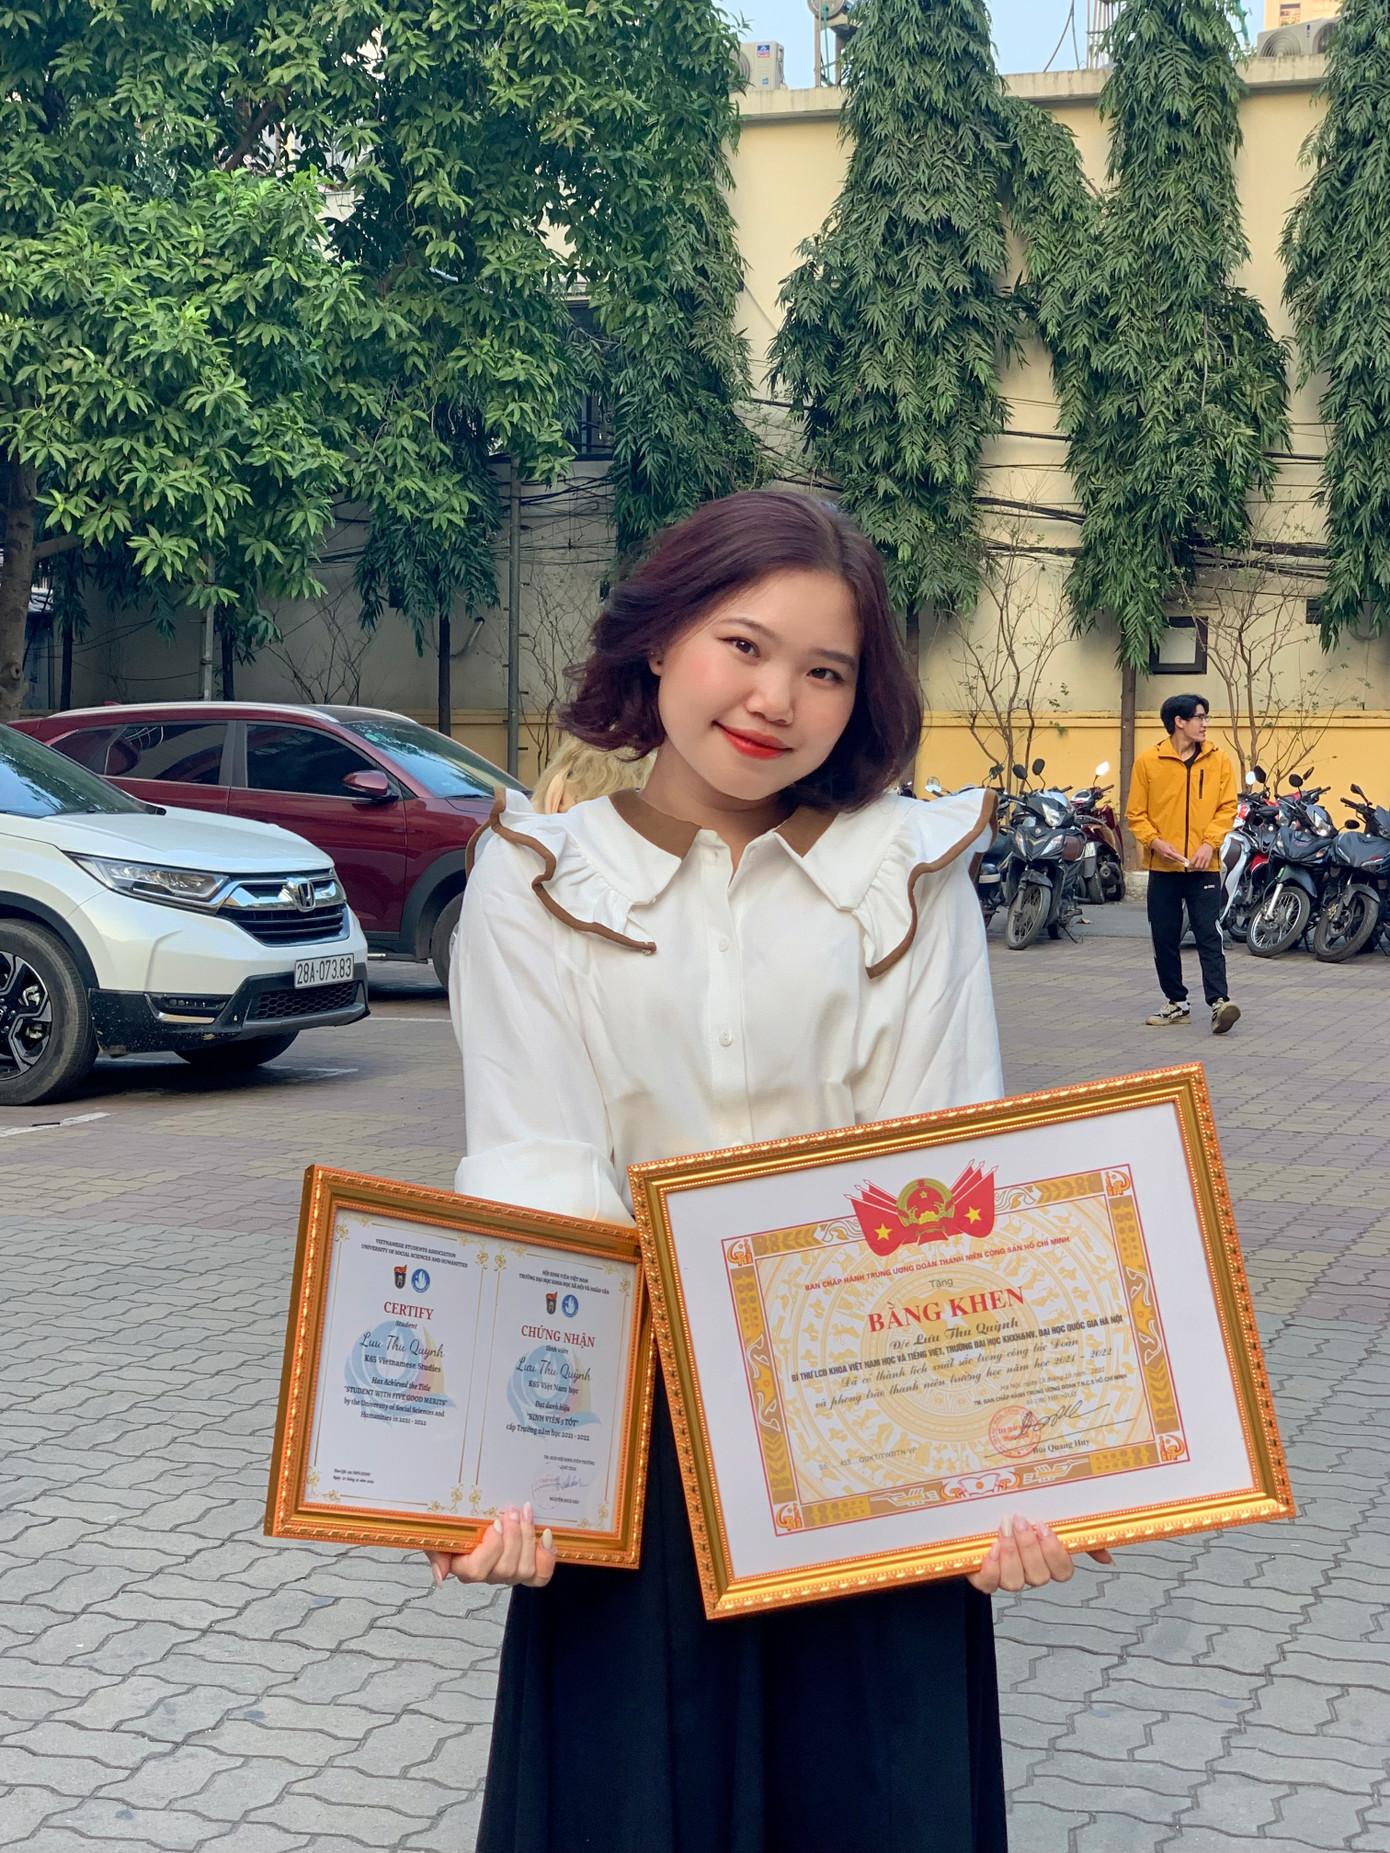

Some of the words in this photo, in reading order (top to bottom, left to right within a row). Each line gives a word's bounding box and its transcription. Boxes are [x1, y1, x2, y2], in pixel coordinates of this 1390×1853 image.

[805, 1282, 821, 1291] BAN
[822, 1277, 842, 1290] CHẤP
[844, 1273, 865, 1284] HÀNH
[866, 1270, 892, 1281] TRUNG
[916, 1260, 937, 1272] ĐOÀN
[939, 1256, 963, 1266] THANH
[1007, 1243, 1023, 1254] SẢN
[1024, 1240, 1035, 1250] HỒ
[1036, 1238, 1049, 1248] CHÍ
[1050, 1236, 1070, 1246] MINH
[384, 1301, 434, 1320] CERTIFY
[868, 1301, 941, 1332] BẰNG
[948, 1286, 1025, 1317] KHEN
[395, 1320, 418, 1329] Student
[944, 1328, 971, 1339] Thu
[387, 1335, 405, 1352] Thu
[521, 1325, 561, 1342] CHỨNG
[563, 1331, 595, 1349] NHẬN
[828, 1366, 847, 1375] KHOA
[848, 1362, 863, 1372] VIỆT
[864, 1359, 880, 1369] NAM
[882, 1356, 896, 1366] HỌC
[897, 1353, 906, 1362] VÀ
[907, 1351, 927, 1360] TIẾNG
[987, 1337, 1001, 1346] HỌC
[1051, 1325, 1066, 1335] HỌC
[1067, 1322, 1085, 1331] QUỐC
[1087, 1320, 1098, 1328] GIA
[1100, 1314, 1110, 1325] HÀ
[1110, 1314, 1123, 1324] NỘI
[364, 1355, 376, 1364] K65
[378, 1357, 416, 1369] Vietnamese
[417, 1363, 441, 1373] Studies
[540, 1359, 557, 1376] Thu
[876, 1367, 904, 1381] thành
[910, 1363, 927, 1375] tích
[977, 1352, 1002, 1364] trong
[1007, 1346, 1029, 1359] công
[816, 1398, 826, 1408] và
[830, 1394, 862, 1410] phong
[889, 1380, 918, 1395] thanh
[924, 1379, 945, 1389] niên
[1007, 1363, 1029, 1374] năm
[1090, 1348, 1112, 1358] 2022
[375, 1390, 392, 1398] WITH
[541, 1382, 552, 1391] Việt
[553, 1384, 567, 1392] Nam
[569, 1386, 578, 1395] học
[1047, 1442, 1073, 1453] Quang
[1074, 1438, 1090, 1447] Huy
